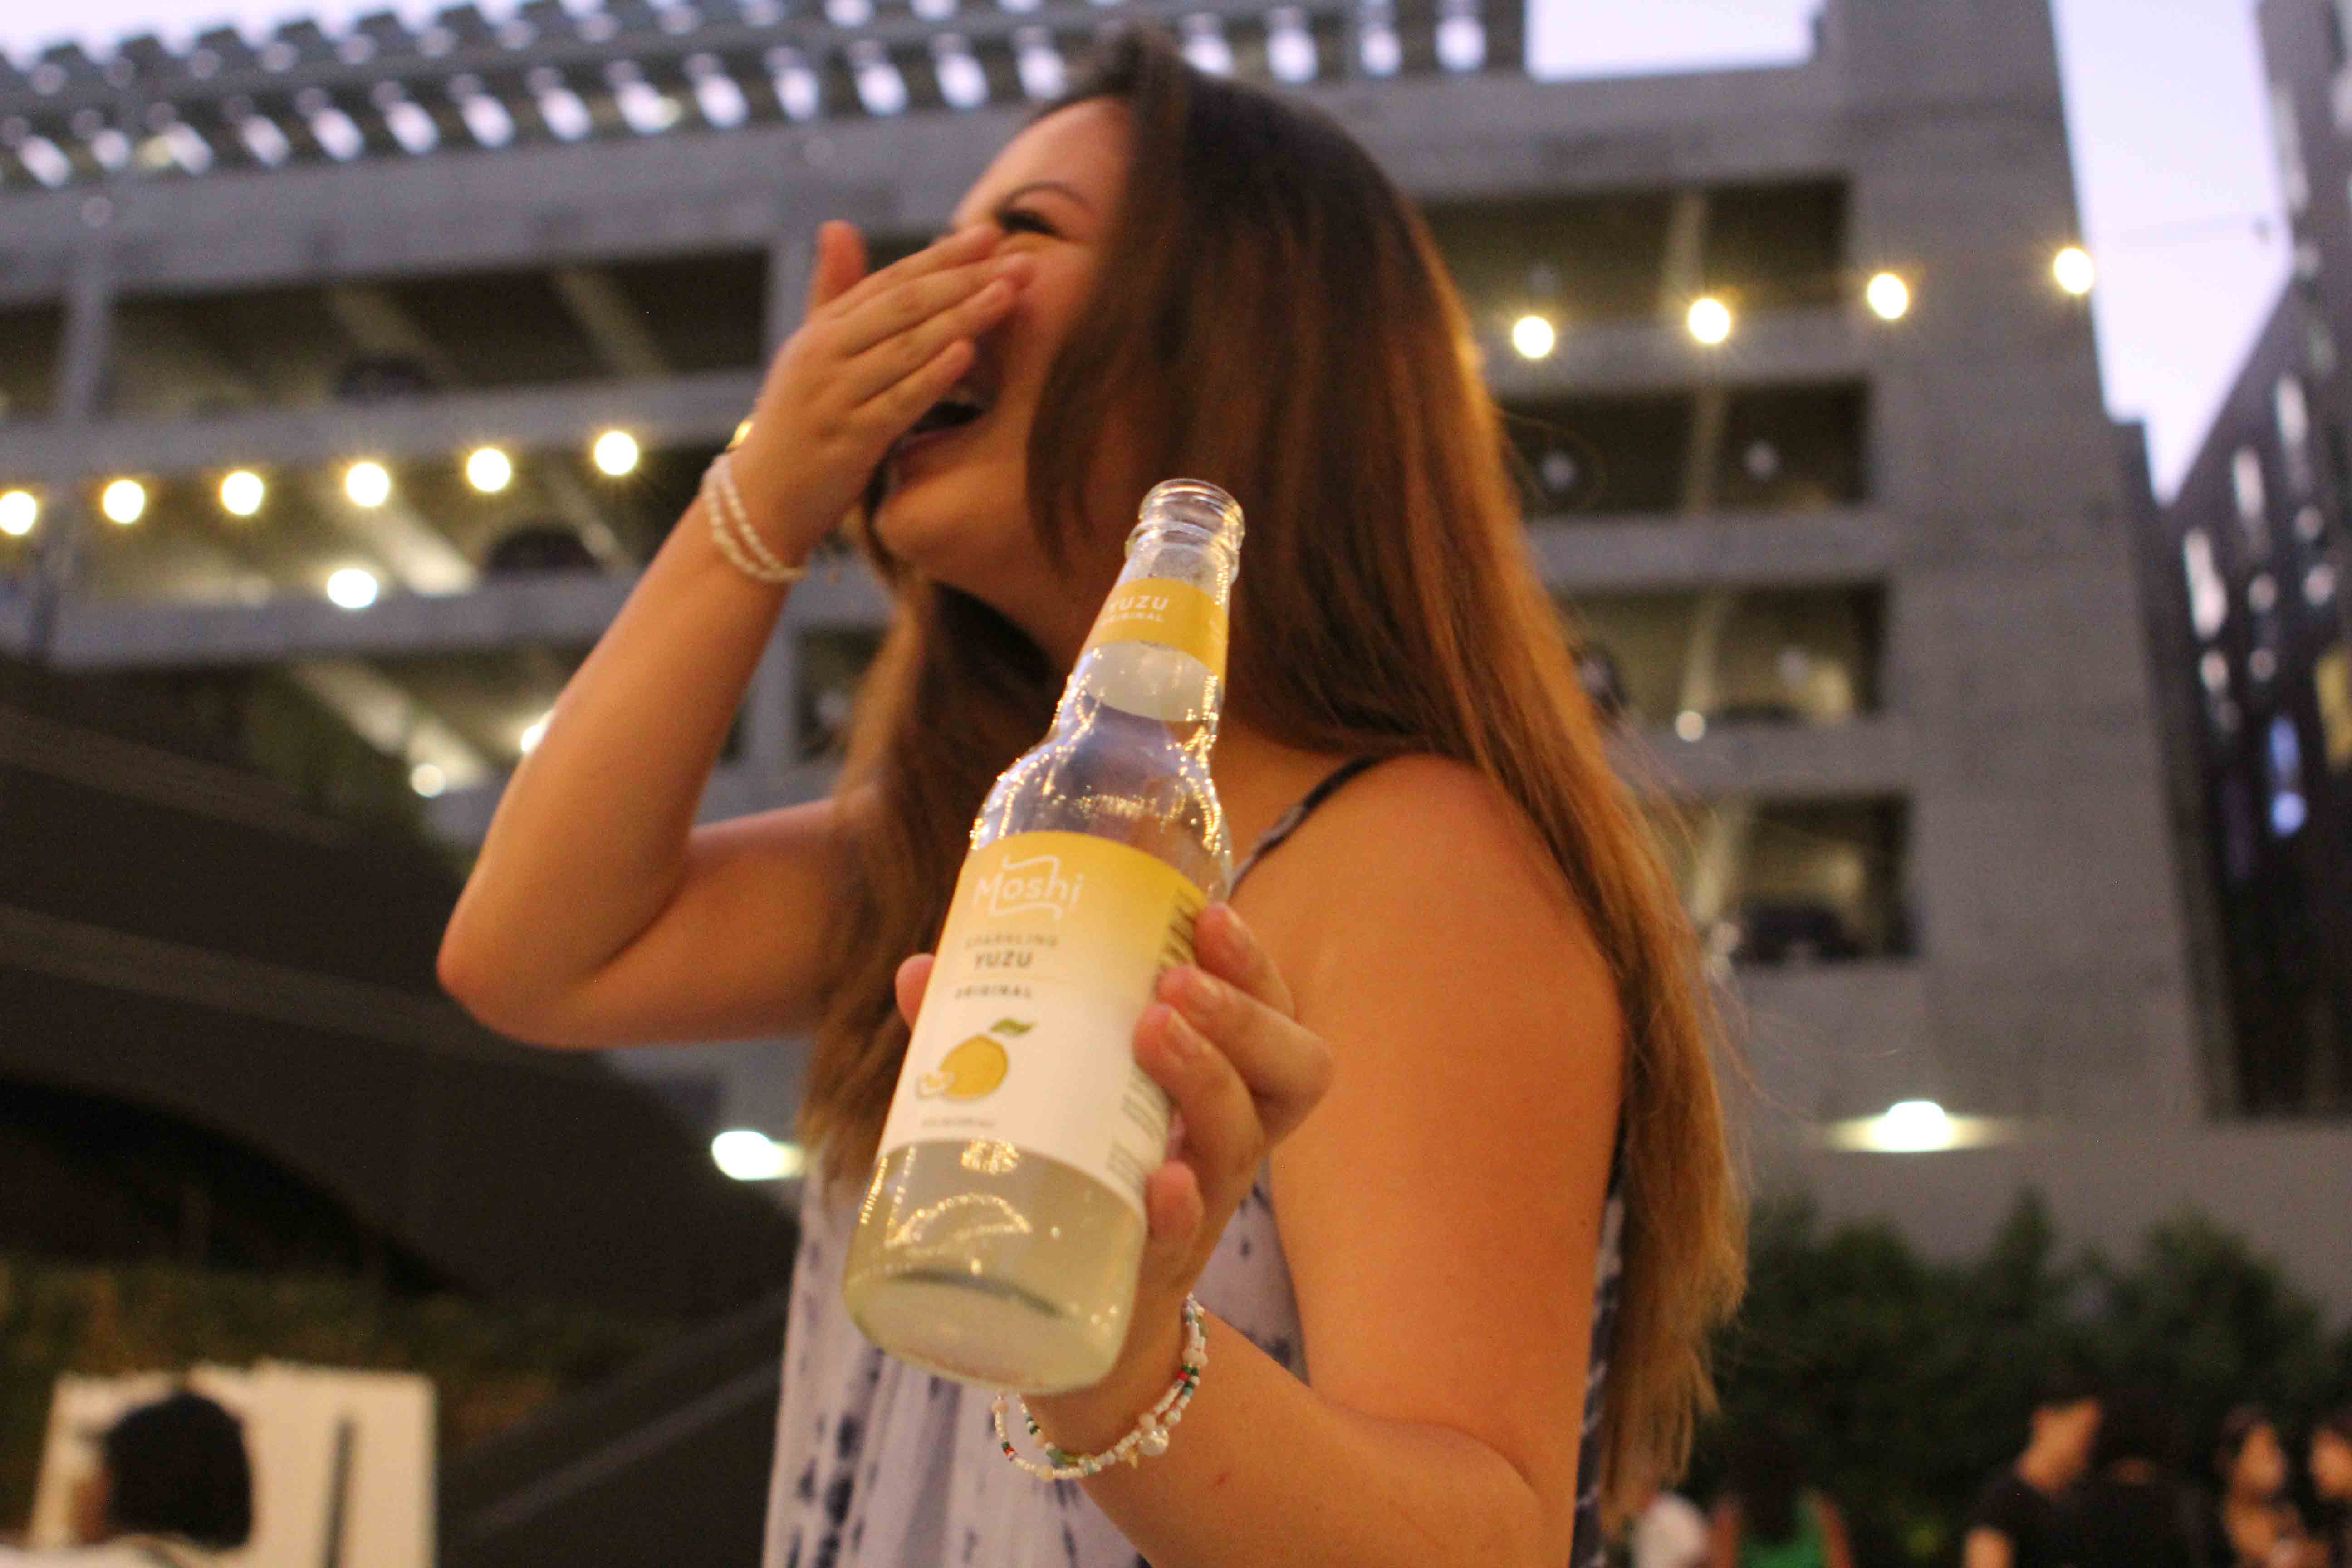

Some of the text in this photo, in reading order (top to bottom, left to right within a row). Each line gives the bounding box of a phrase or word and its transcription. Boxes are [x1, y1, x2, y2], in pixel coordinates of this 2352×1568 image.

[1109, 595, 1169, 611] YUZU
[973, 854, 1084, 921] Moshi
[974, 951, 1032, 969] YUZU
